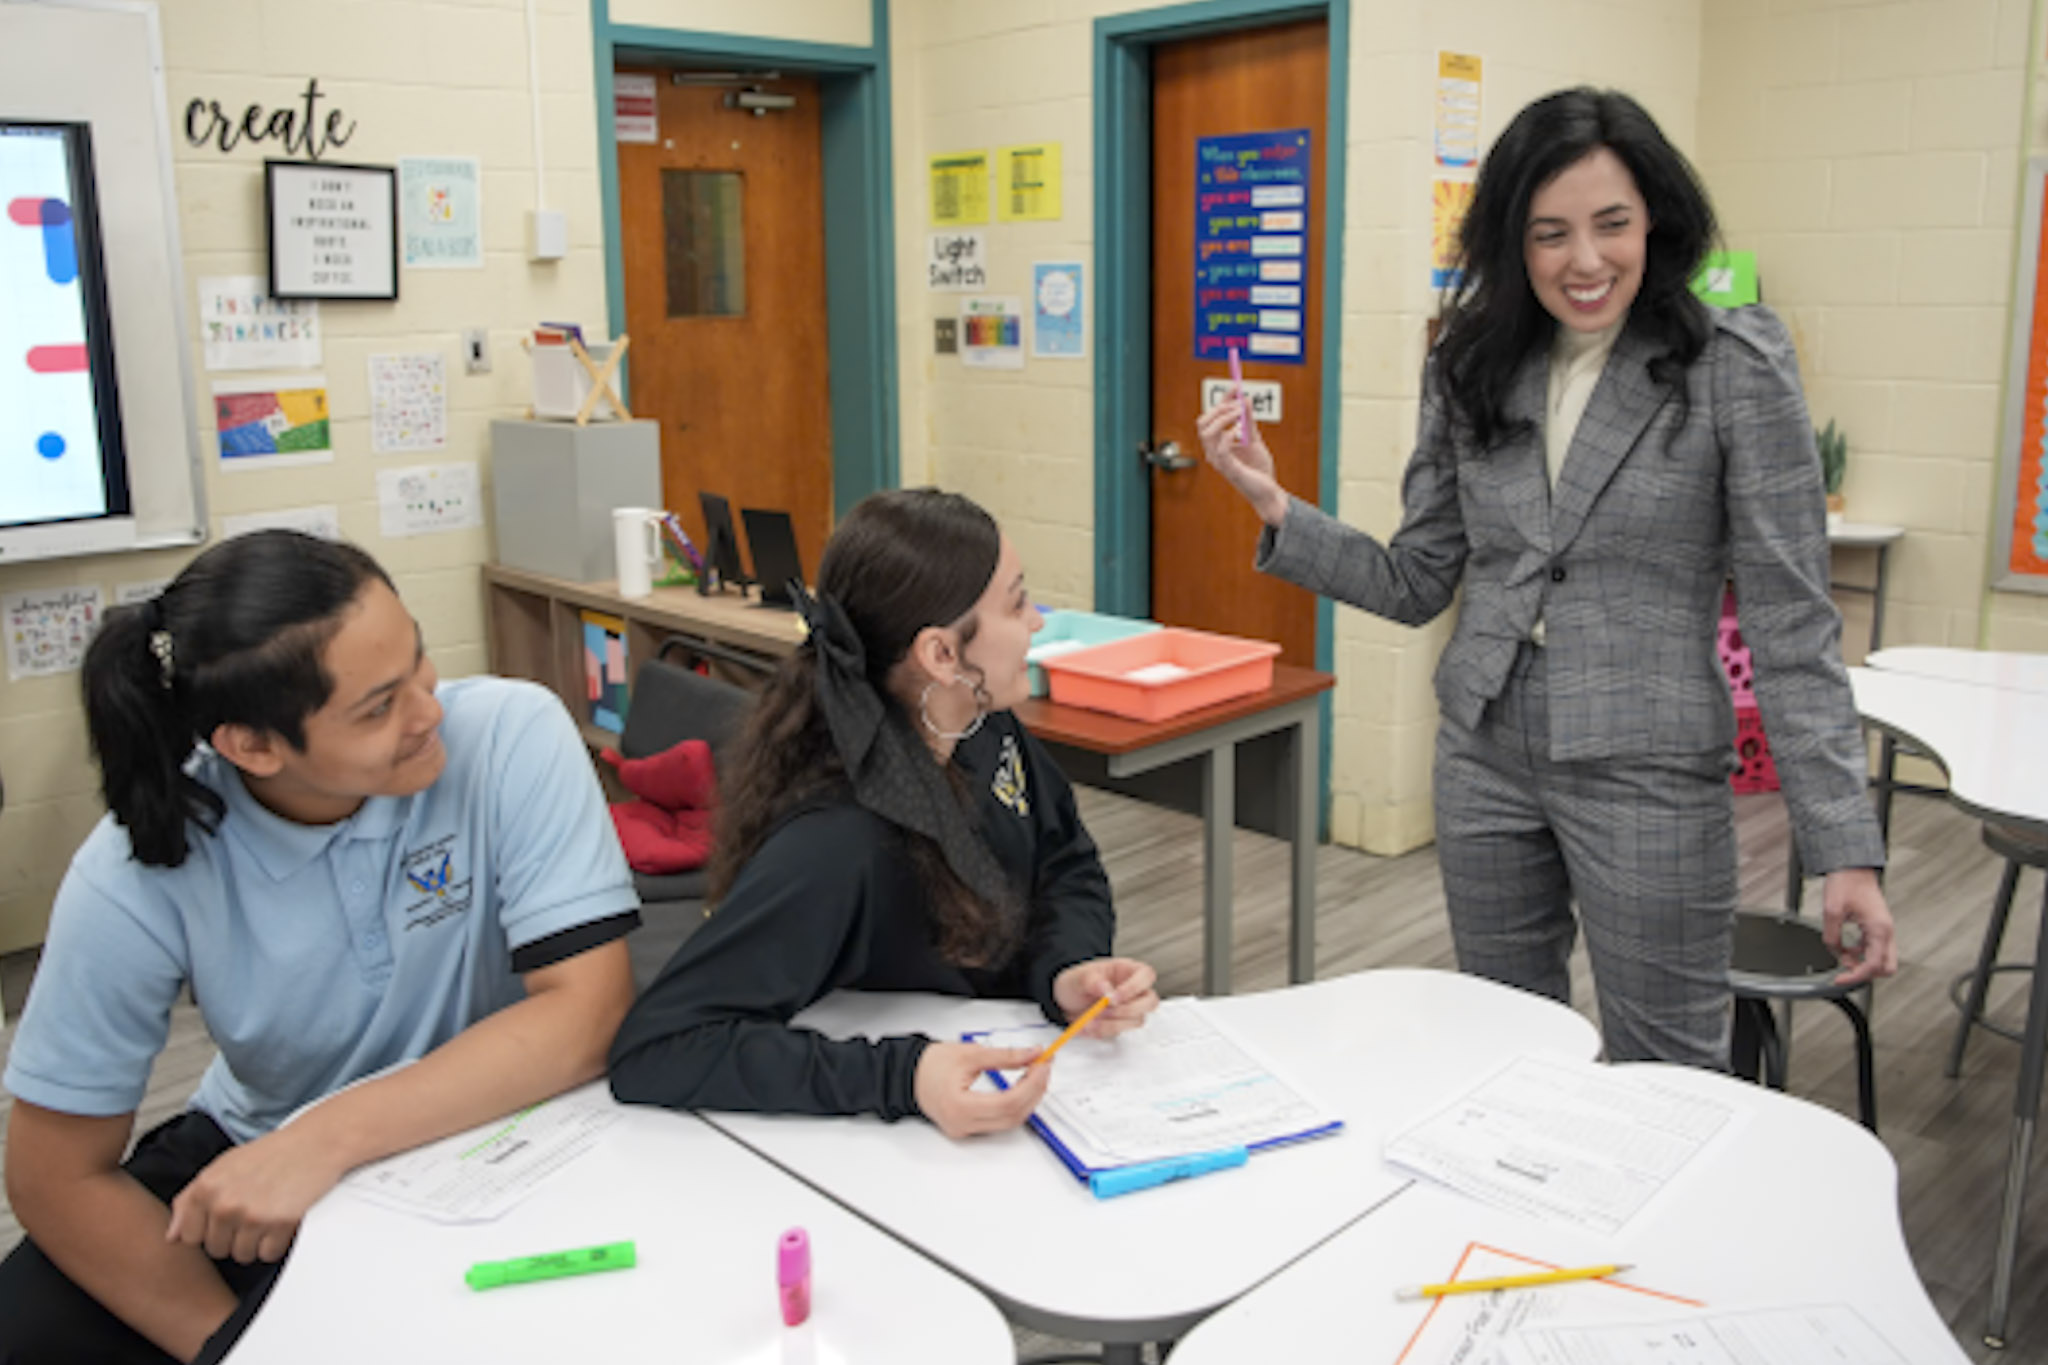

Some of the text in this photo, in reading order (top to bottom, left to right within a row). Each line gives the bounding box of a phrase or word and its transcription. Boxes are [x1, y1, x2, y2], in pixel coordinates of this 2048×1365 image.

[185, 78, 357, 160] create
[1201, 192, 1224, 212] you
[1228, 190, 1250, 204] are
[1209, 217, 1234, 235] you
[1236, 216, 1260, 228] are
[934, 236, 976, 264] Light
[1201, 241, 1223, 260] you
[1227, 240, 1250, 254] are
[929, 264, 986, 288] Switch
[1209, 265, 1233, 284] you
[1236, 264, 1258, 277] are
[1200, 288, 1223, 308] you
[1226, 288, 1249, 301] are
[1208, 312, 1233, 331] you
[1236, 312, 1258, 325] are
[1200, 336, 1223, 354] you
